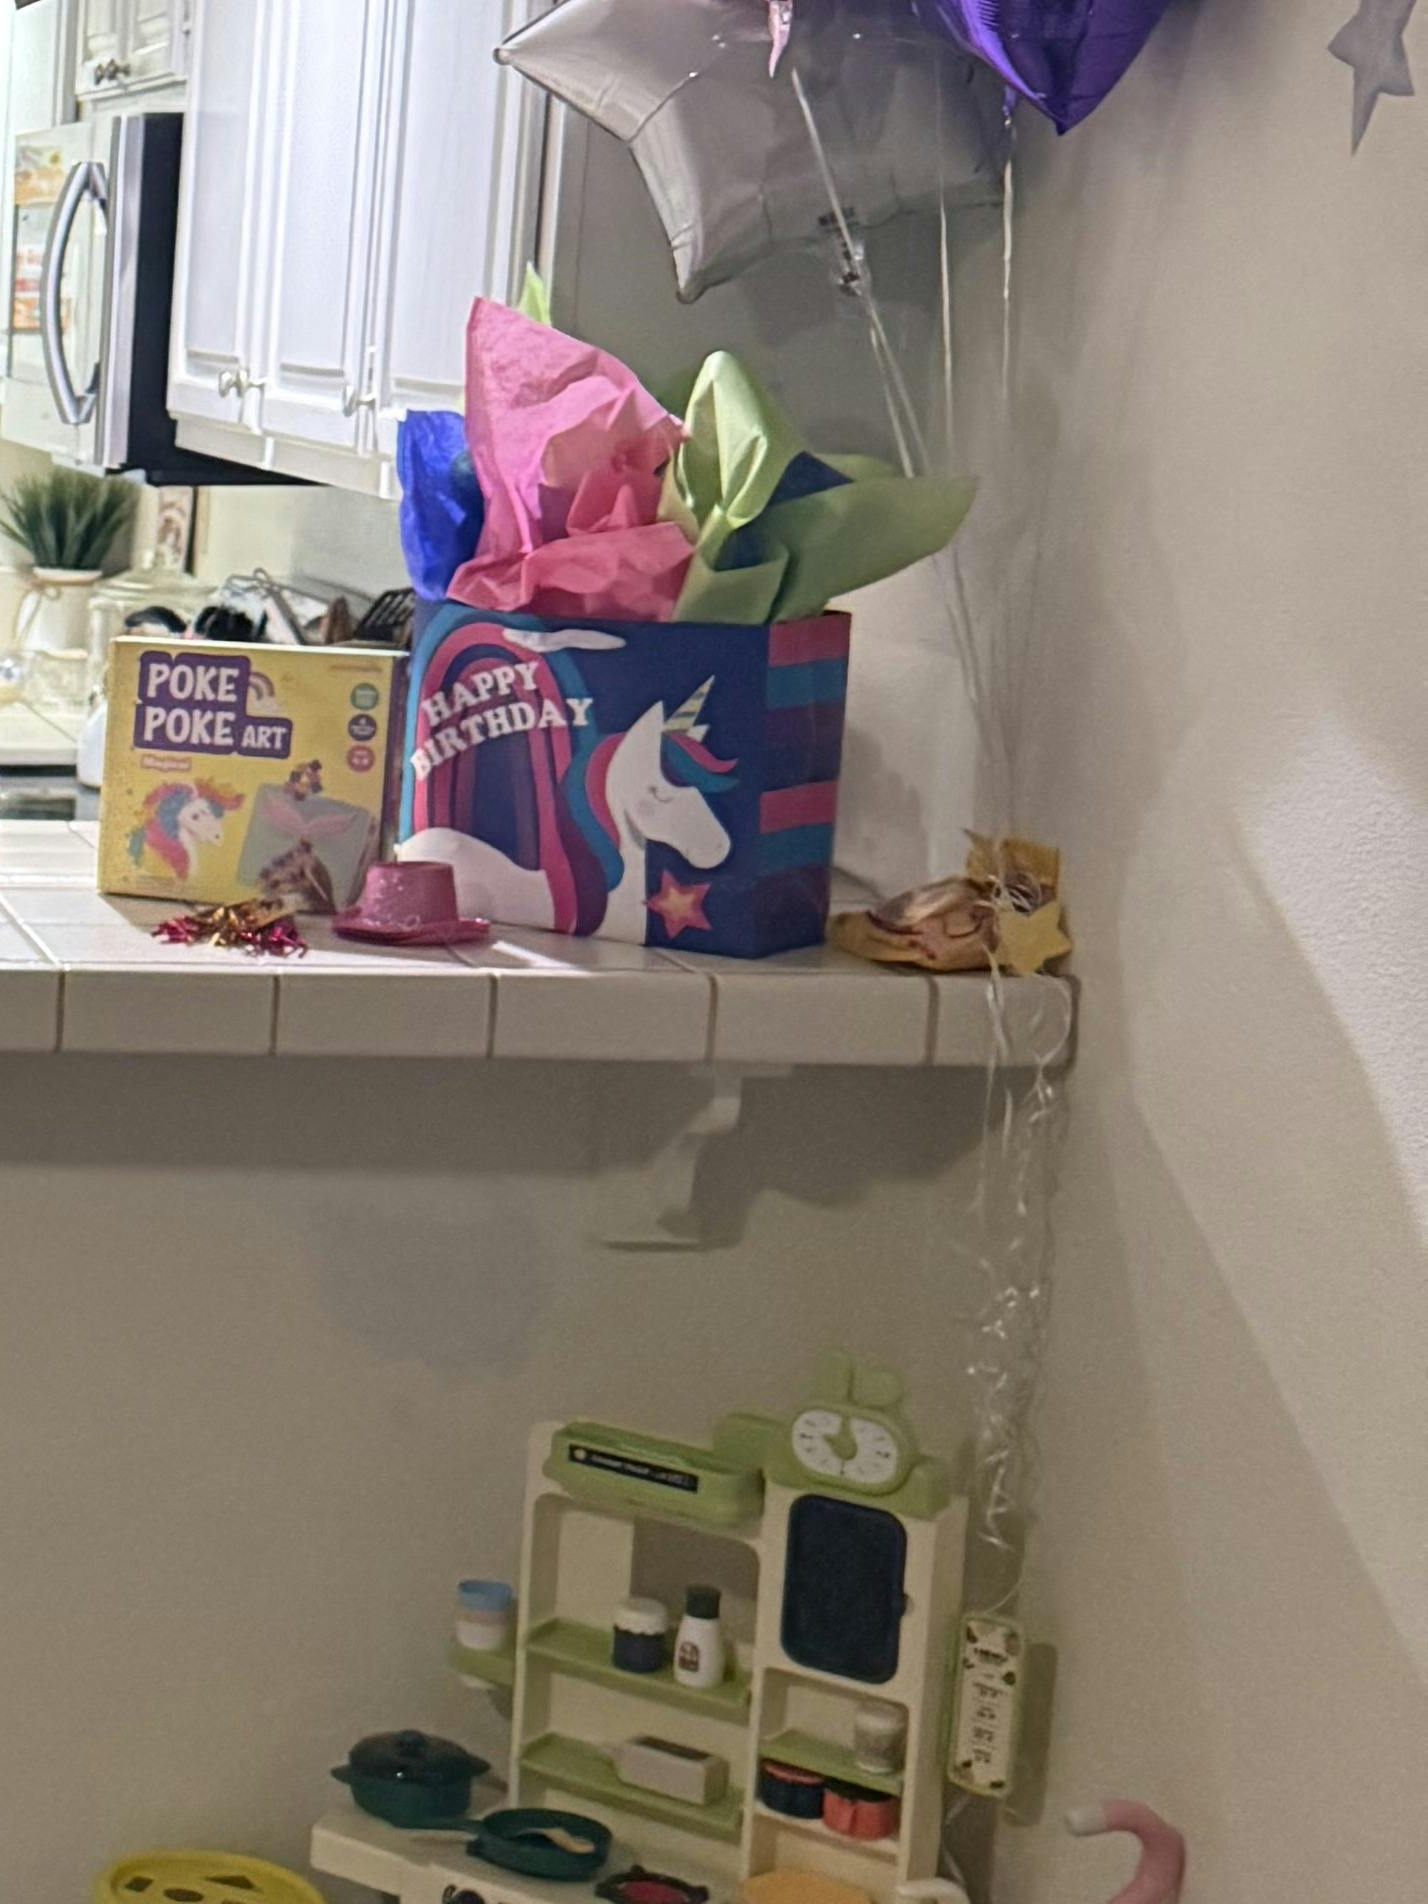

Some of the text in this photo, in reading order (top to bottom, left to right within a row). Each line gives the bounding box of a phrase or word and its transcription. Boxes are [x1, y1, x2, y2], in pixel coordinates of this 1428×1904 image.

[146, 662, 240, 703] POKE
[421, 661, 540, 727] HAPPY
[143, 705, 288, 750] POKE ART
[410, 697, 593, 781] BIRTHDAY
